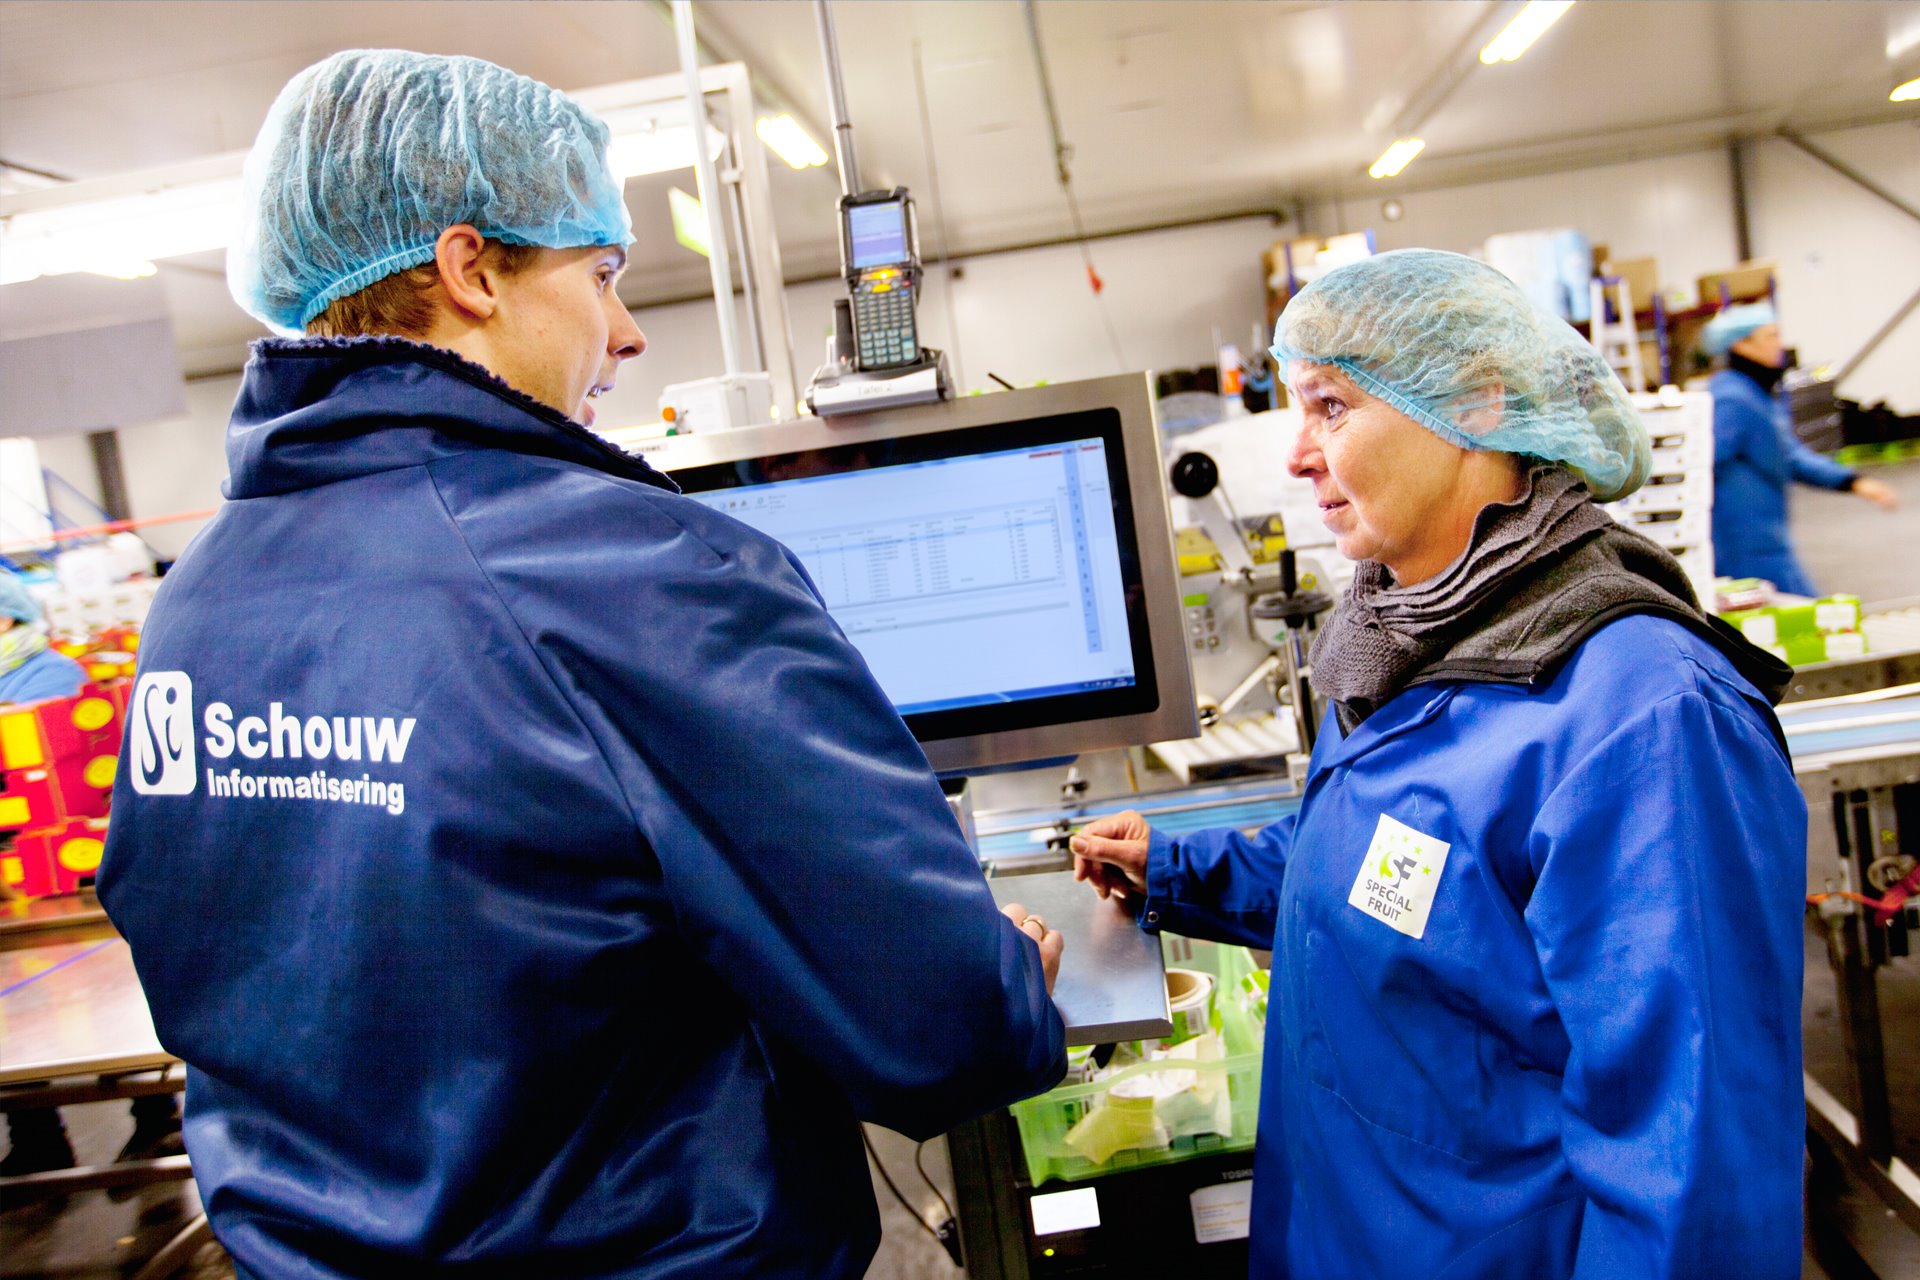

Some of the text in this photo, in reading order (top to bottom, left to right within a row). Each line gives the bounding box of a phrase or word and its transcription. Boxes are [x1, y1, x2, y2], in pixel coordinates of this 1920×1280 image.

[204, 701, 417, 763] Schouw
[207, 768, 405, 815] Informatisering
[1365, 879, 1413, 912] SPECIAL
[1367, 896, 1402, 921] FRUIT
